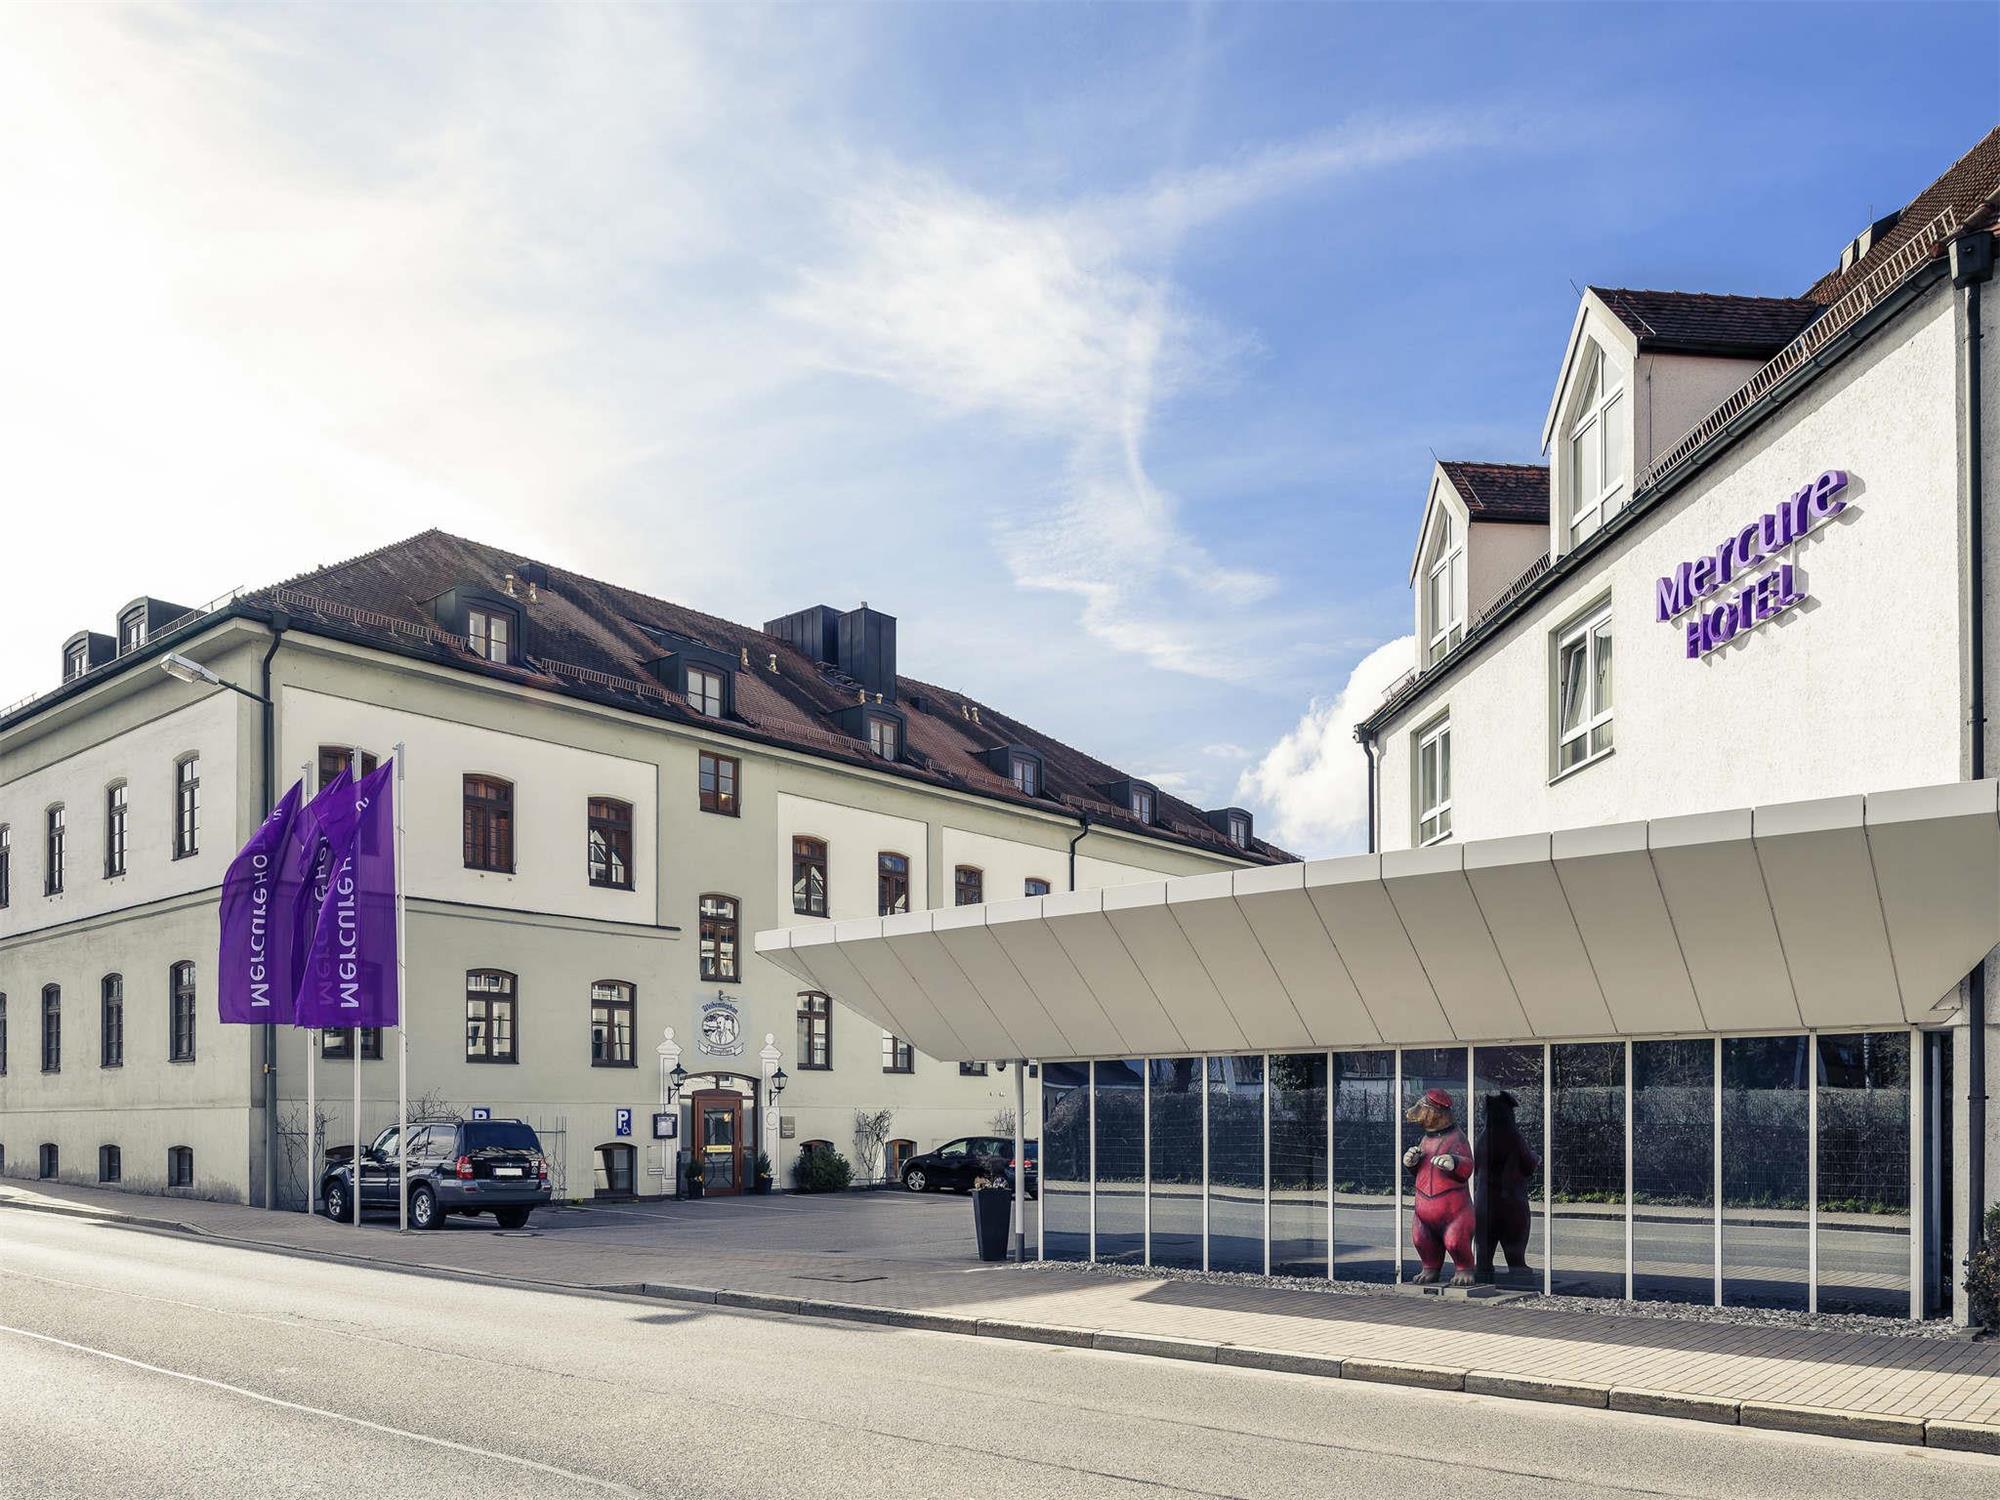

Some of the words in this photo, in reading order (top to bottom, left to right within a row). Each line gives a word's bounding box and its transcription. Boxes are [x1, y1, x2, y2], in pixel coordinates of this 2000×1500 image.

[1656, 470, 1848, 623] Mercure
[1686, 565, 1806, 659] HOTEL
[617, 1110, 629, 1129] P
